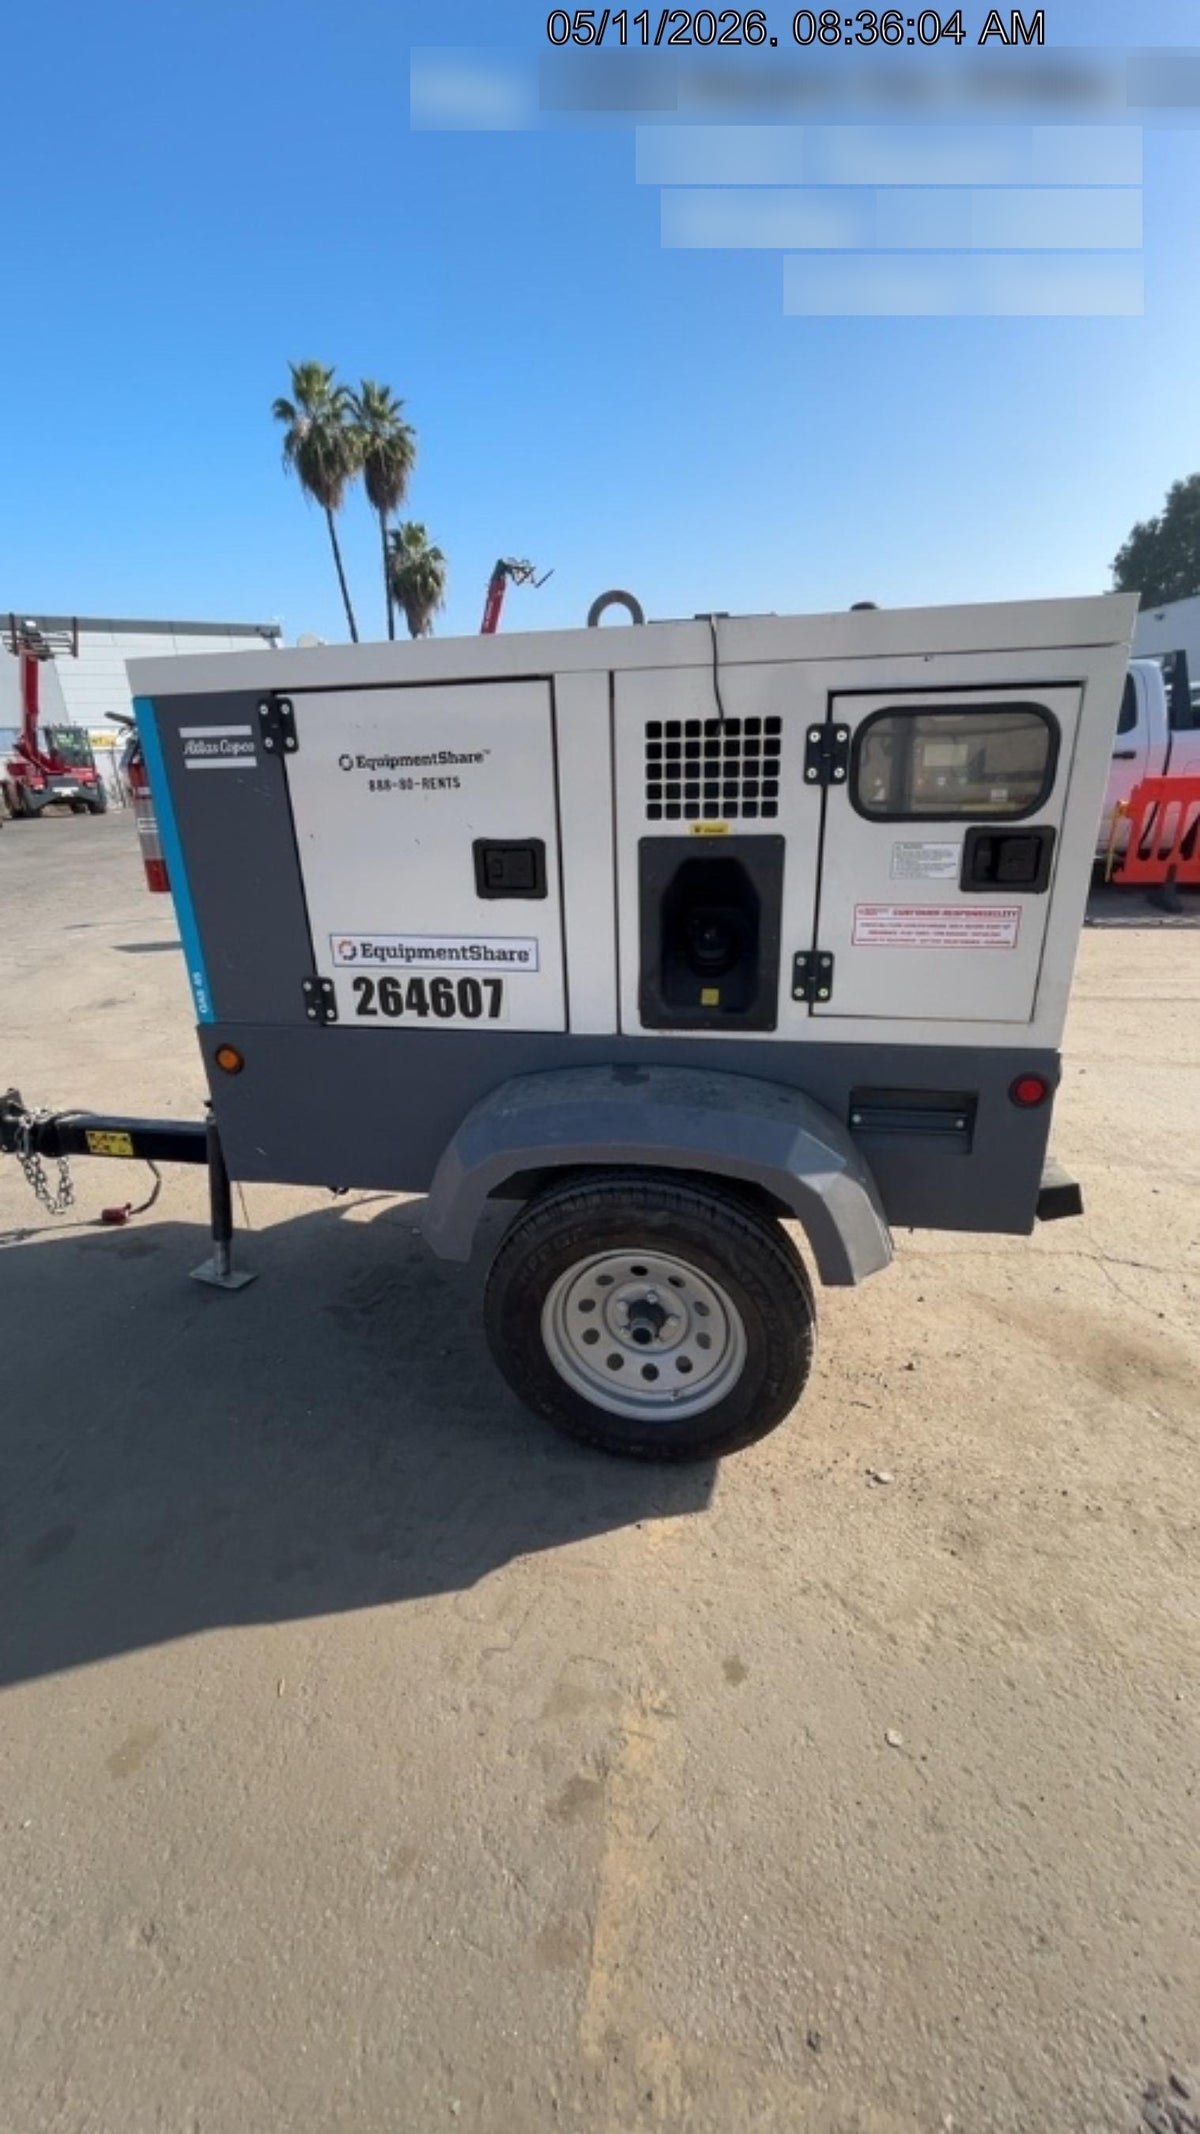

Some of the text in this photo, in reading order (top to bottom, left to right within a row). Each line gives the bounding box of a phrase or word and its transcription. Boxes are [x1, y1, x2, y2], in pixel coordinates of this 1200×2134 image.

[183, 739, 255, 755] Atlas Copco
[360, 943, 530, 963] EquipmentShare
[352, 976, 504, 1019] 264607
